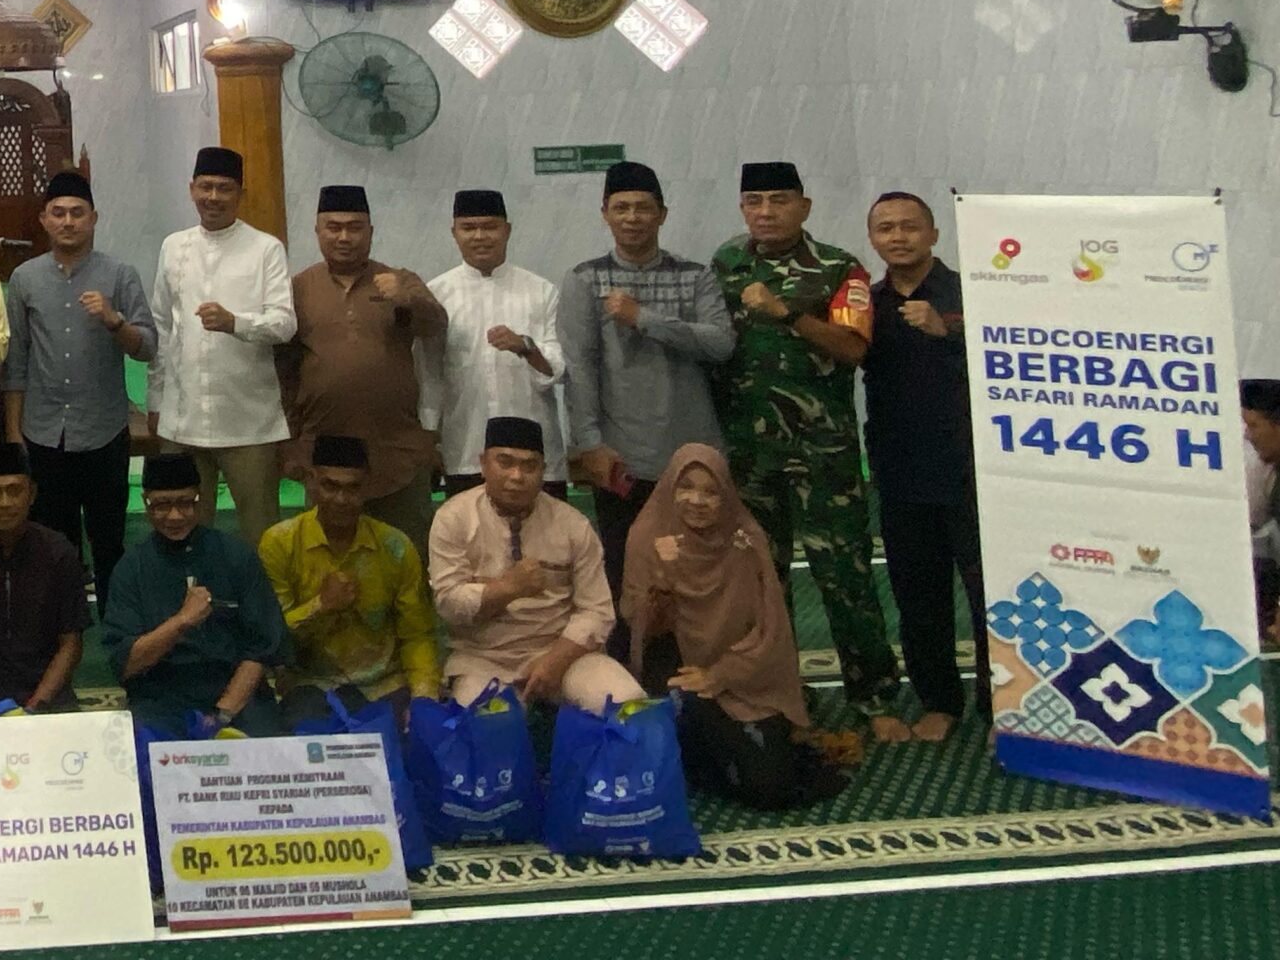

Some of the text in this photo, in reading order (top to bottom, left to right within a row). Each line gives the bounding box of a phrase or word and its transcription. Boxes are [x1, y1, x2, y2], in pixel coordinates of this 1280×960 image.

[982, 325, 1214, 355] MEDCOENERGI
[984, 350, 1218, 394] BERBAGI
[987, 386, 1220, 417] SAFARI RAMADAN
[991, 414, 1224, 471] 1446 H
[200, 771, 345, 787] BANTUAN PROGRAM KEMITRAAN
[192, 792, 218, 802] BANK
[220, 791, 241, 801] RIAU
[243, 790, 270, 800] KEPRI
[272, 787, 311, 799] SYARIAH
[259, 804, 294, 815] KEPADA
[49, 813, 135, 834] BERBAGI
[171, 814, 386, 834] PEMERINTAH KABUPATEN KEPULAUAN ANAMBAS
[72, 841, 119, 859] 1446
[123, 840, 137, 856] H
[182, 838, 381, 875] Rp. 123.500.000,-
[205, 886, 237, 898] UNTUK
[252, 883, 287, 895] MASJID
[288, 882, 308, 894] DAN
[321, 880, 367, 891] MUSHOLA
[180, 900, 236, 912] KECAMATAN
[252, 895, 306, 908] KABUPATEN
[307, 893, 362, 906] KEPULAUAN
[364, 889, 408, 902] ANAMBAS
